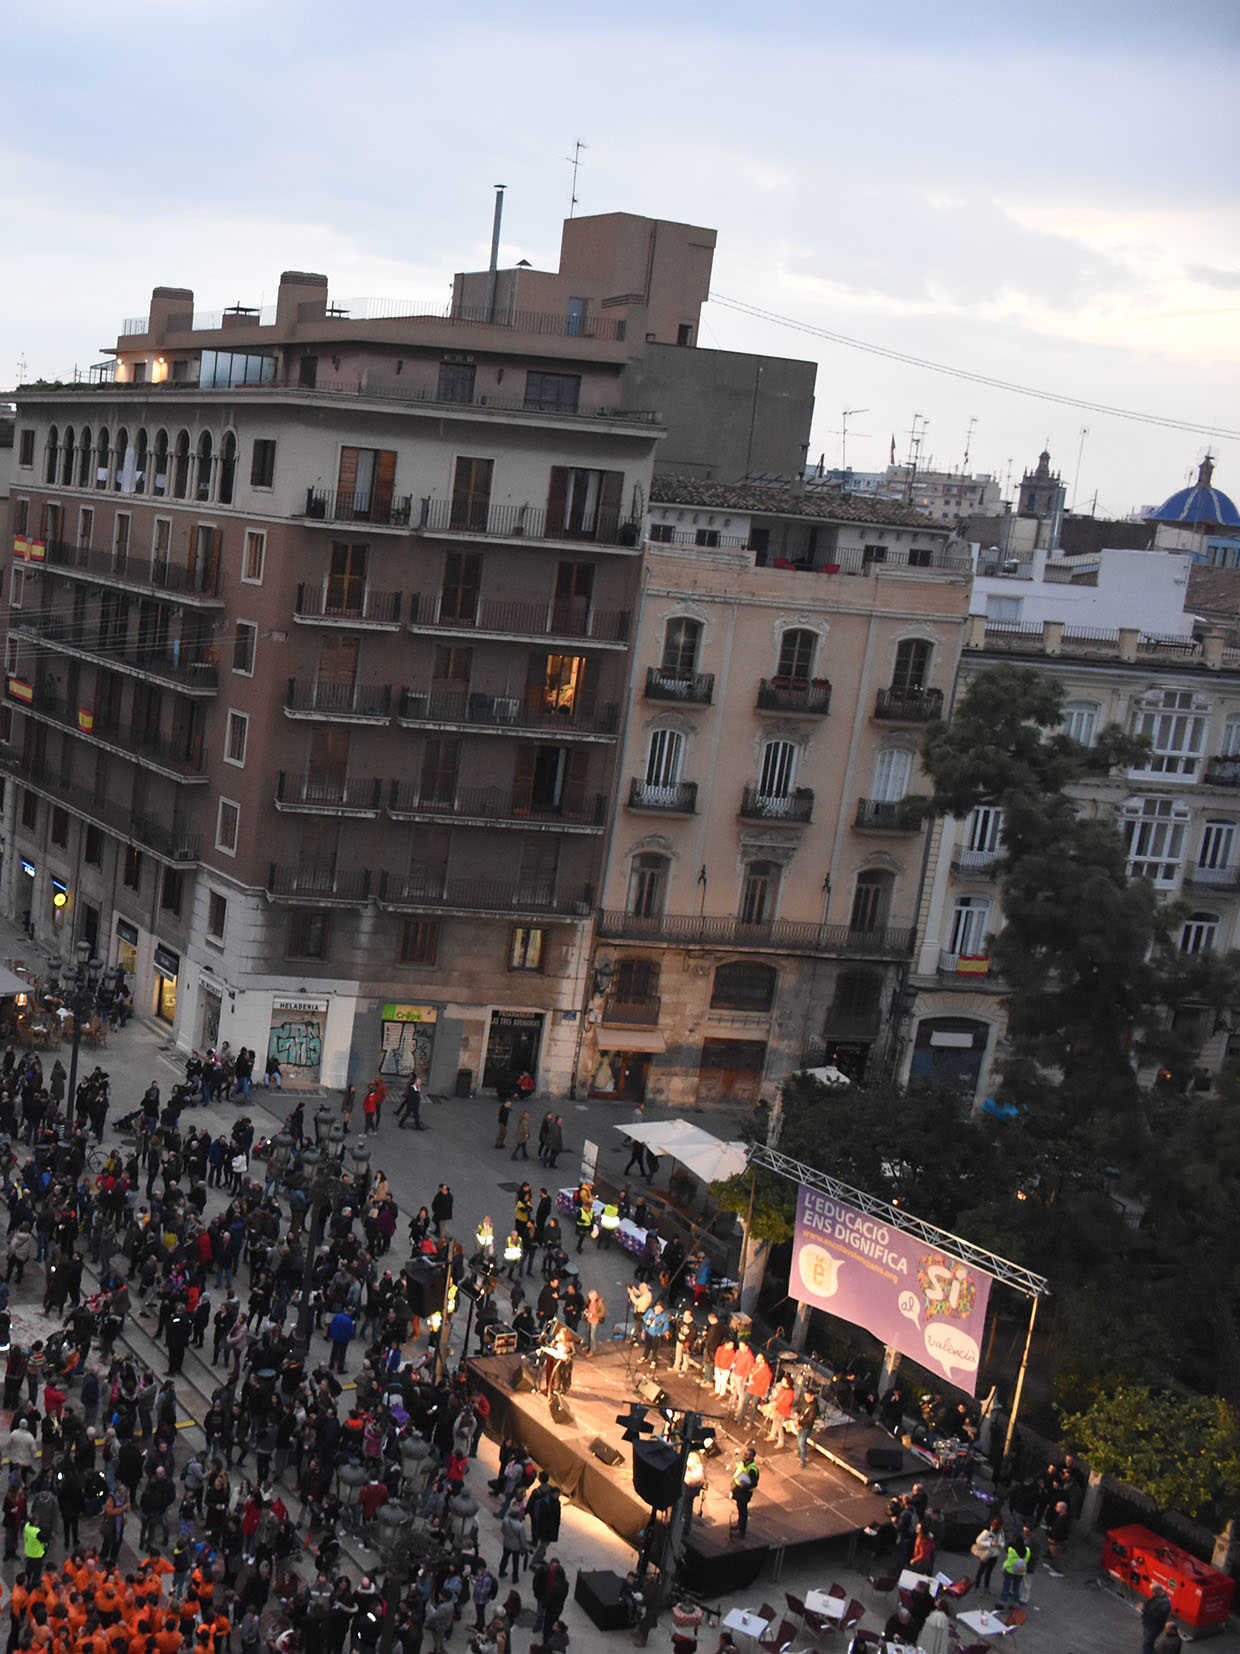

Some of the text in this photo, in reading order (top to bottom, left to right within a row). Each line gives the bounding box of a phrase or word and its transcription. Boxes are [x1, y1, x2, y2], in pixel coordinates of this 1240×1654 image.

[803, 1210, 908, 1275] ENS DIGNIFICA
[804, 1193, 890, 1246] L'EDUCACIÓ
[901, 1296, 914, 1312] al
